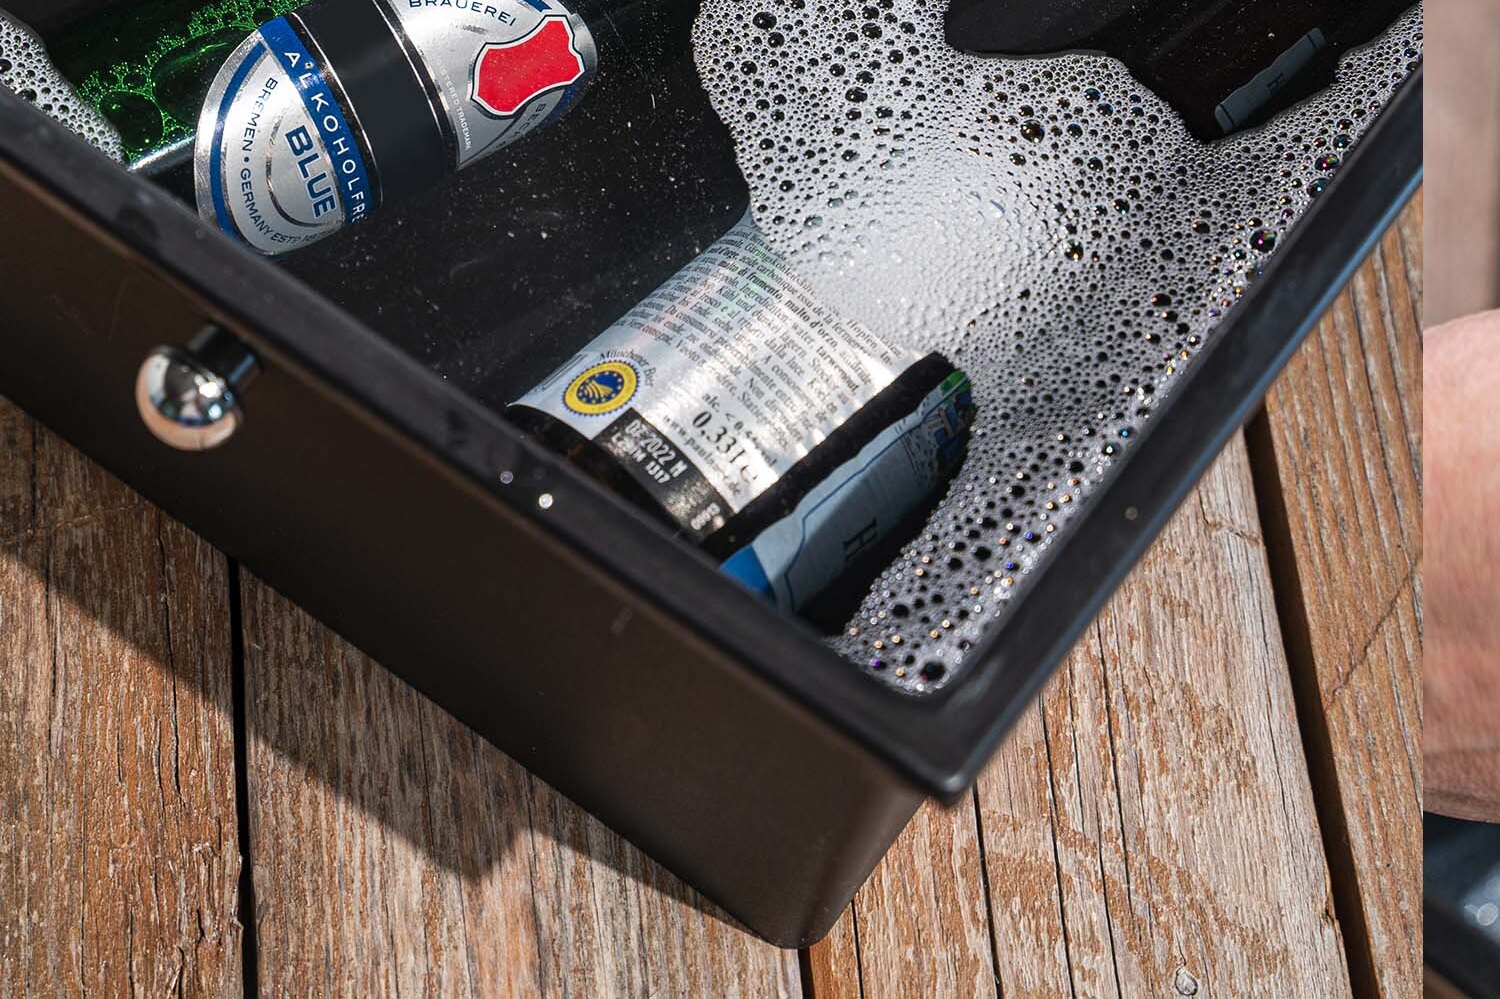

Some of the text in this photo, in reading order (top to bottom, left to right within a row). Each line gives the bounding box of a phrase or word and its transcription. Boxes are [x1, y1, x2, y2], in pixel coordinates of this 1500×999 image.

[240, 77, 278, 235] BREMEN GERMANY
[285, 125, 337, 218] BLUE
[784, 297, 812, 322] malto
